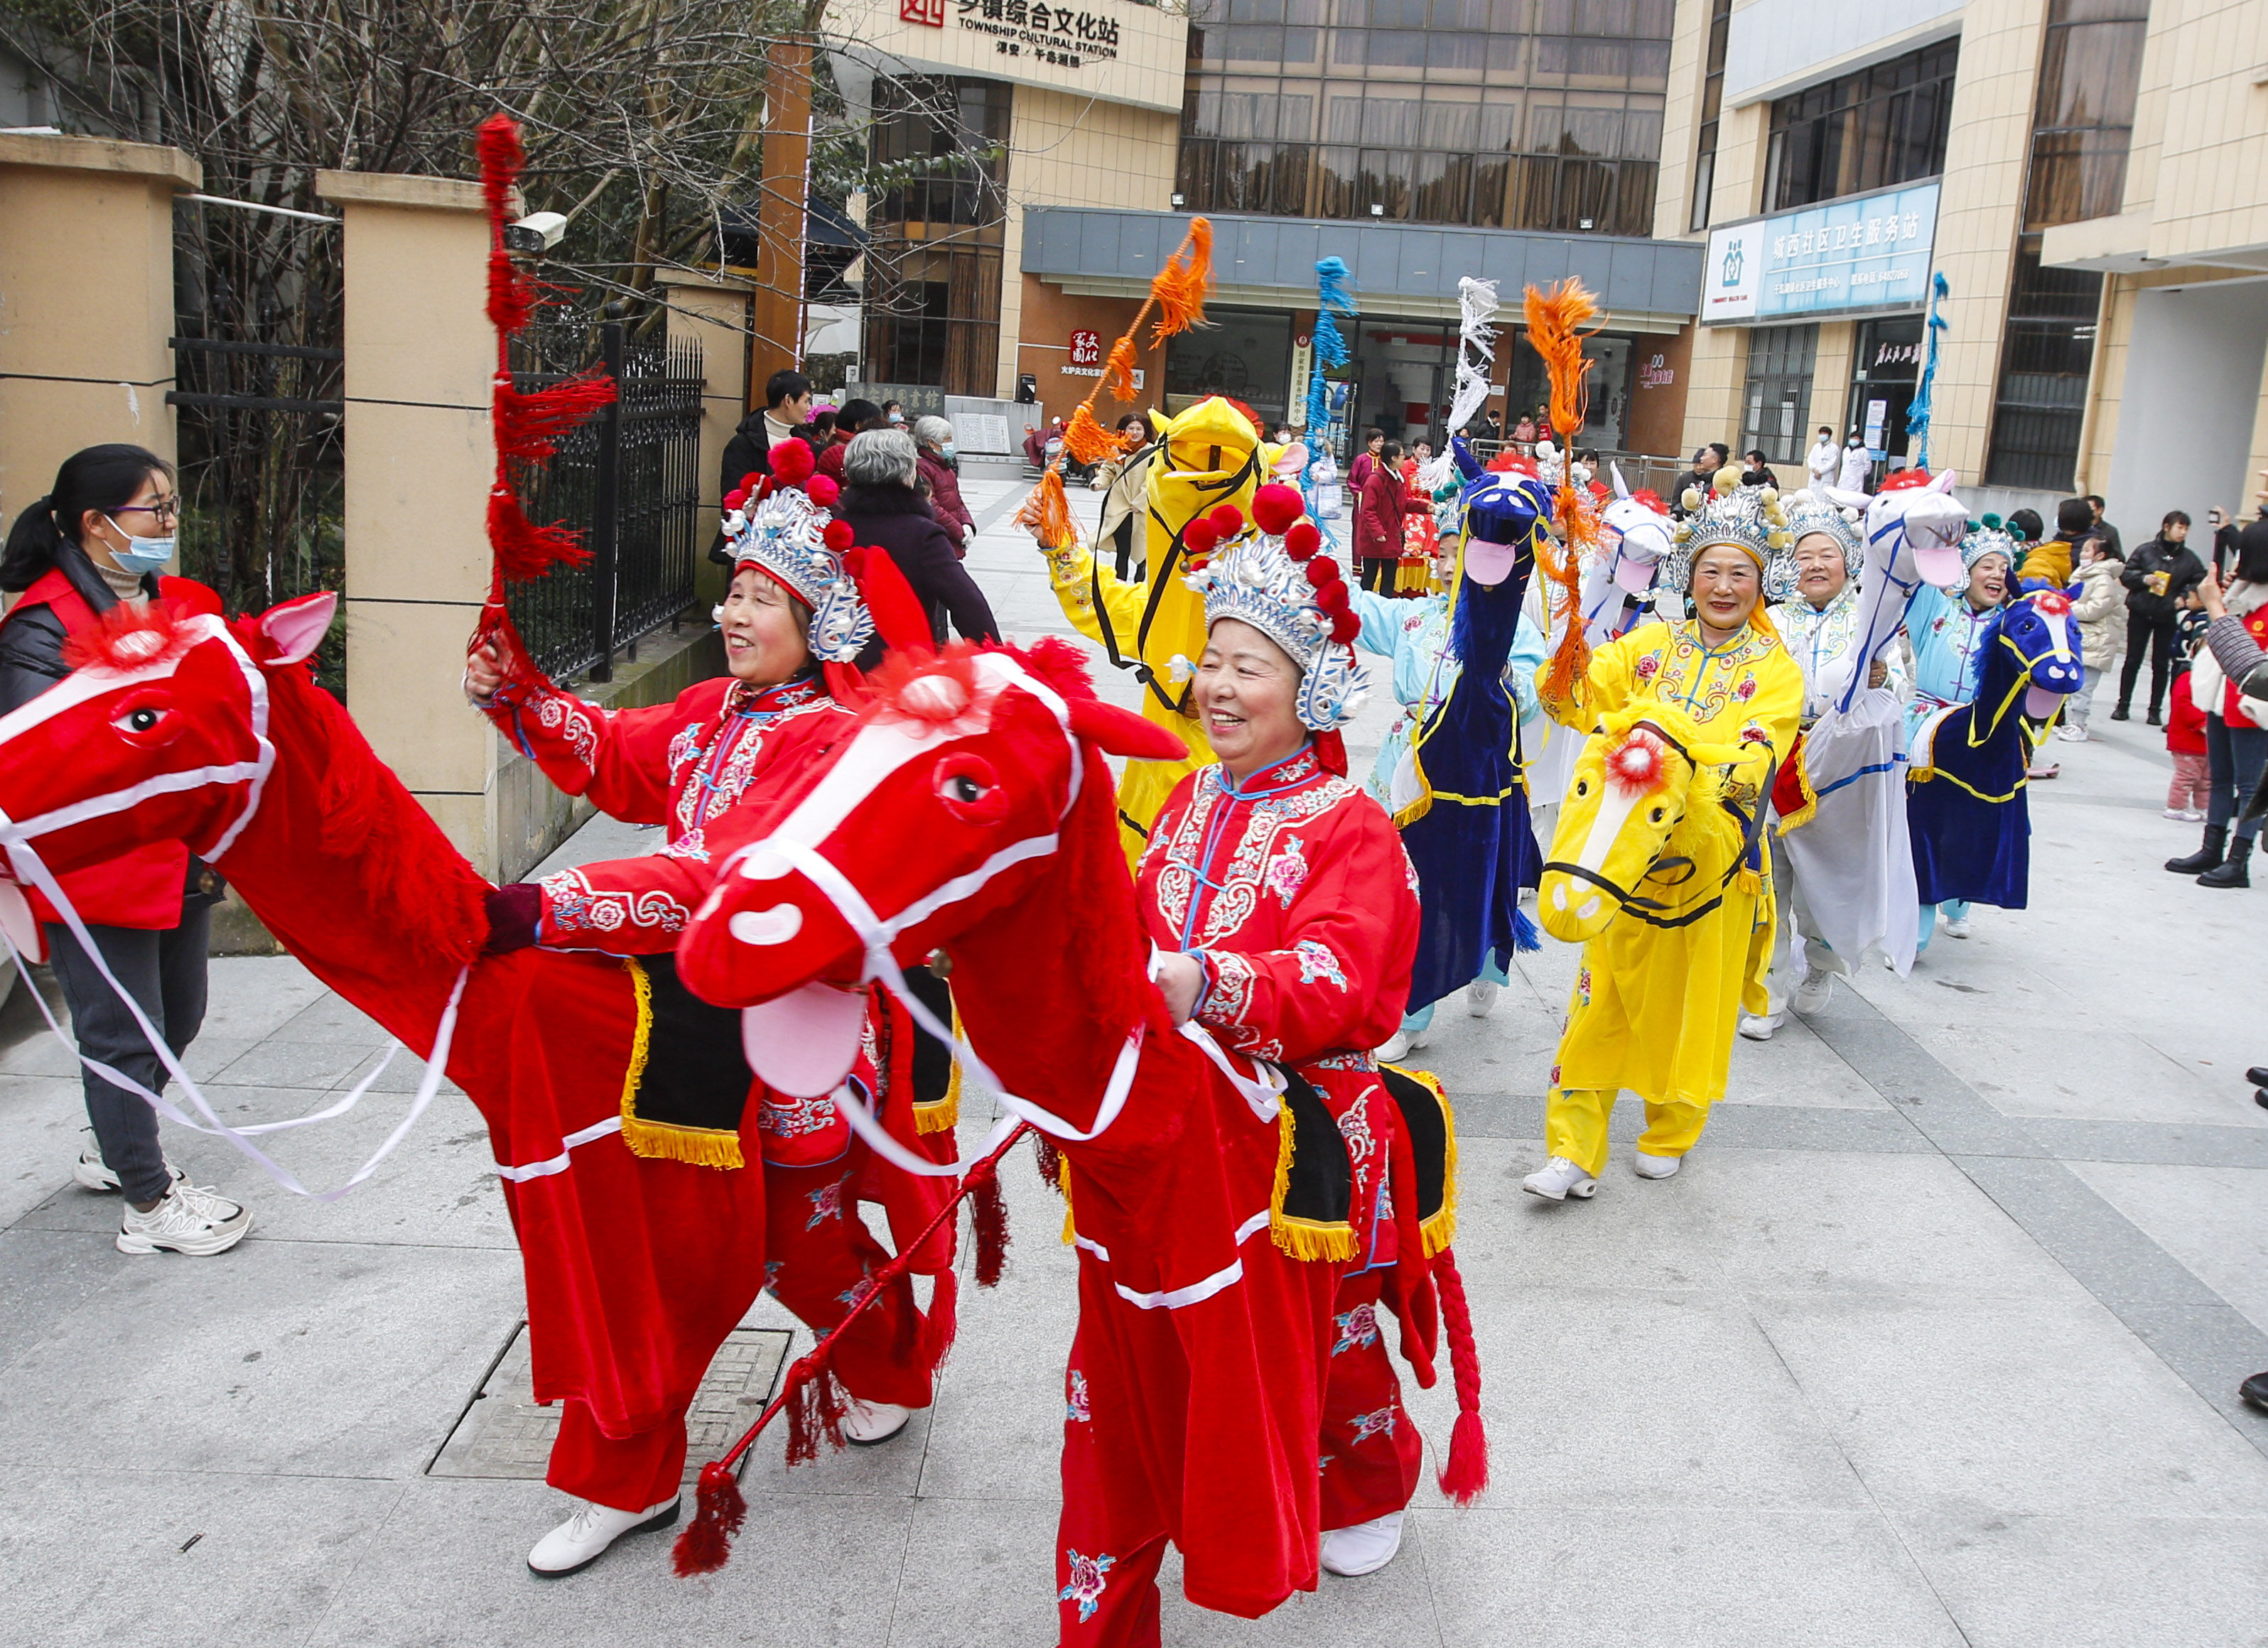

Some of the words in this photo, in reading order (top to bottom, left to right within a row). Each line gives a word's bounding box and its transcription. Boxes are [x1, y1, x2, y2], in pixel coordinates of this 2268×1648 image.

[959, 18, 1017, 38] TOWNSHIP
[1019, 31, 1073, 50] CULTURAL
[1075, 42, 1117, 58] STATION
[1773, 211, 1919, 260] 城西社区卫生服务站
